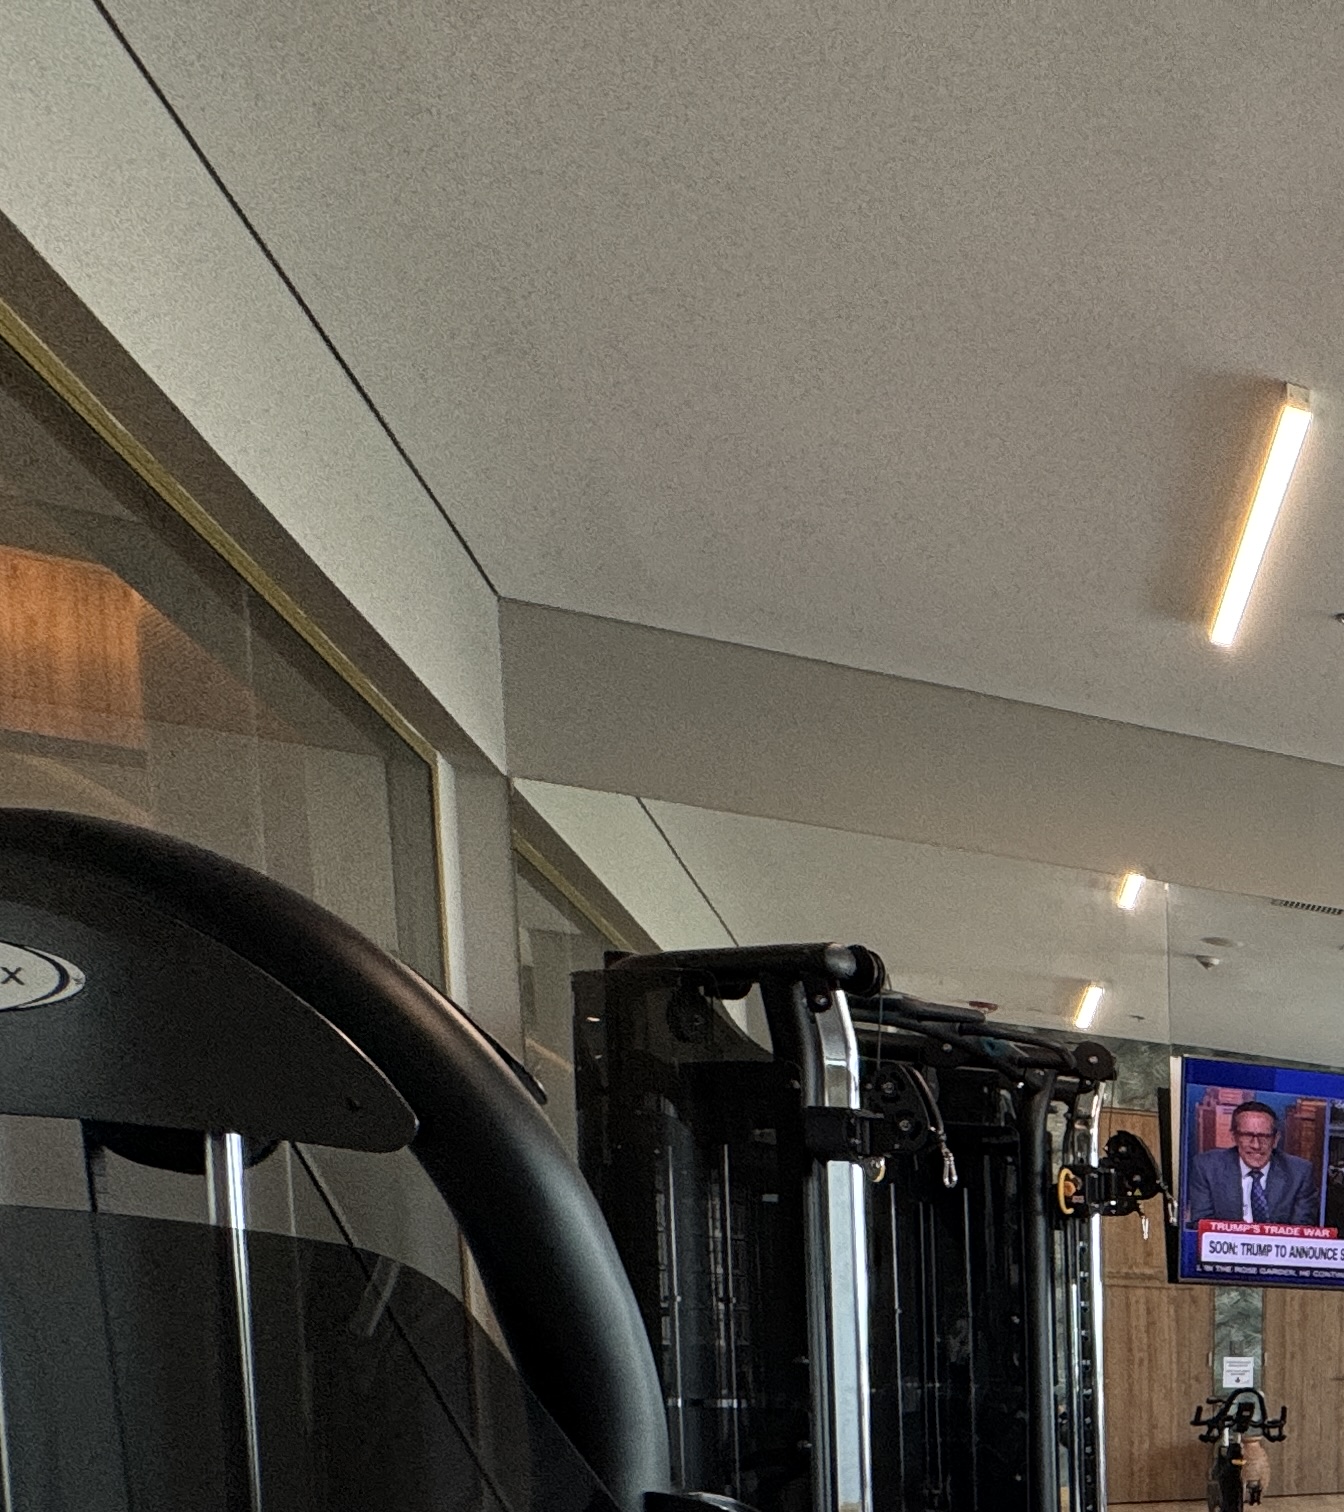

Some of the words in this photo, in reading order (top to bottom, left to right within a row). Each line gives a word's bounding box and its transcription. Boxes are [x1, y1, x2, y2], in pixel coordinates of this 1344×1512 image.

[1210, 1221, 1263, 1234] TRUMP'S
[1263, 1225, 1300, 1236] TRADE
[1304, 1227, 1331, 1238] WAR
[1209, 1240, 1238, 1255] SOON:
[1240, 1242, 1272, 1257] TRUMP
[1275, 1244, 1287, 1258] TO
[1288, 1246, 1338, 1261] ANNOUNCE
